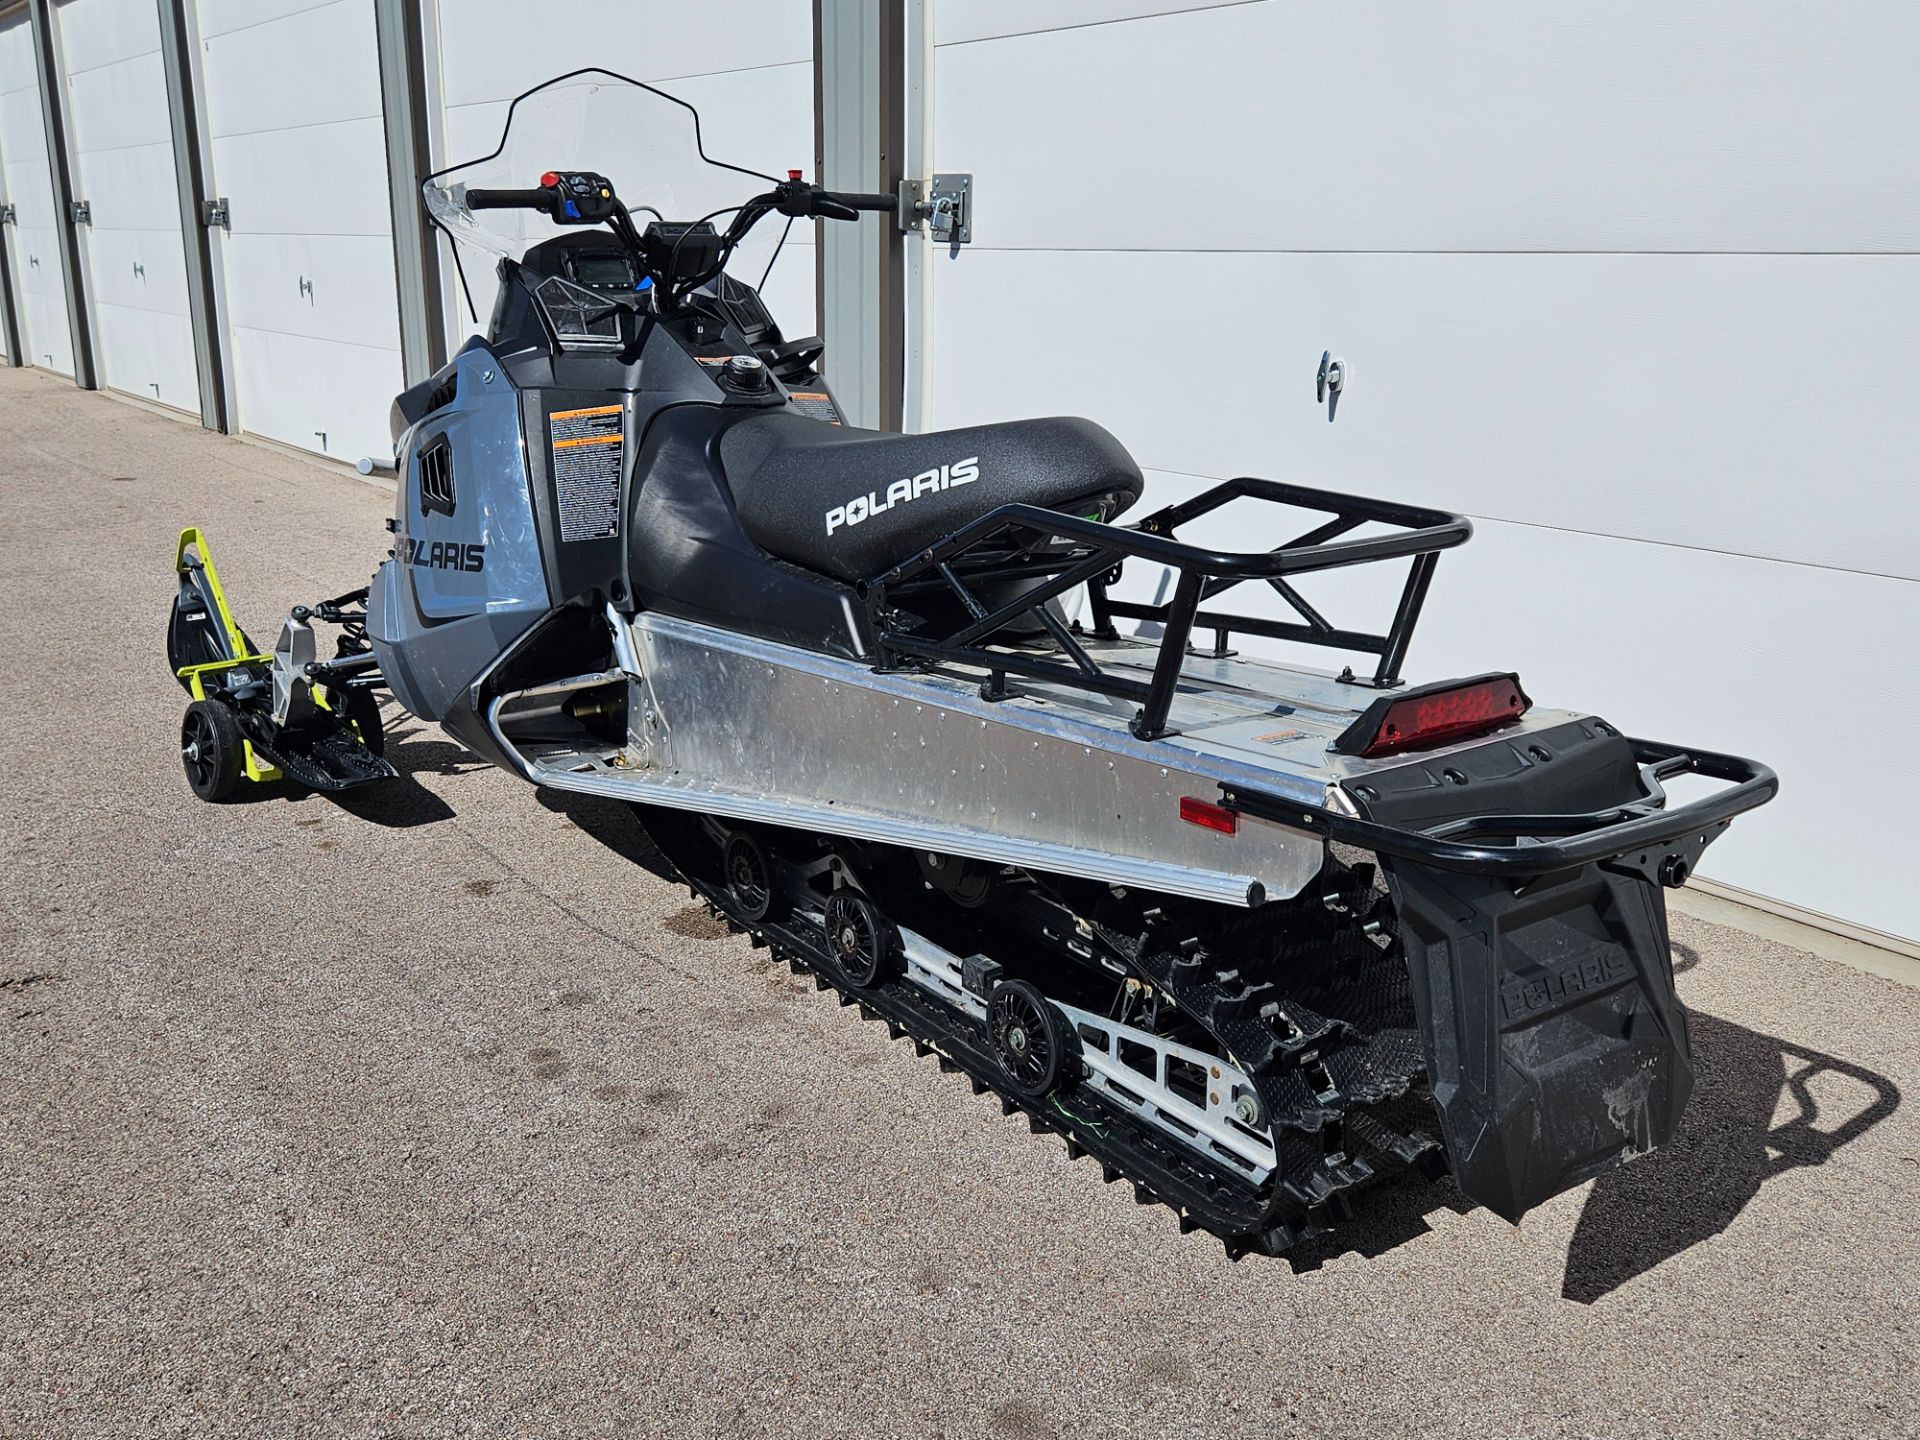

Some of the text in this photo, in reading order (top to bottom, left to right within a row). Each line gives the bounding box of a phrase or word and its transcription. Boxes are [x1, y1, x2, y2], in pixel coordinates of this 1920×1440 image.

[825, 456, 980, 537] POLARIS
[396, 538, 486, 573] POLARIS
[1501, 951, 1626, 1019] POLARIS
